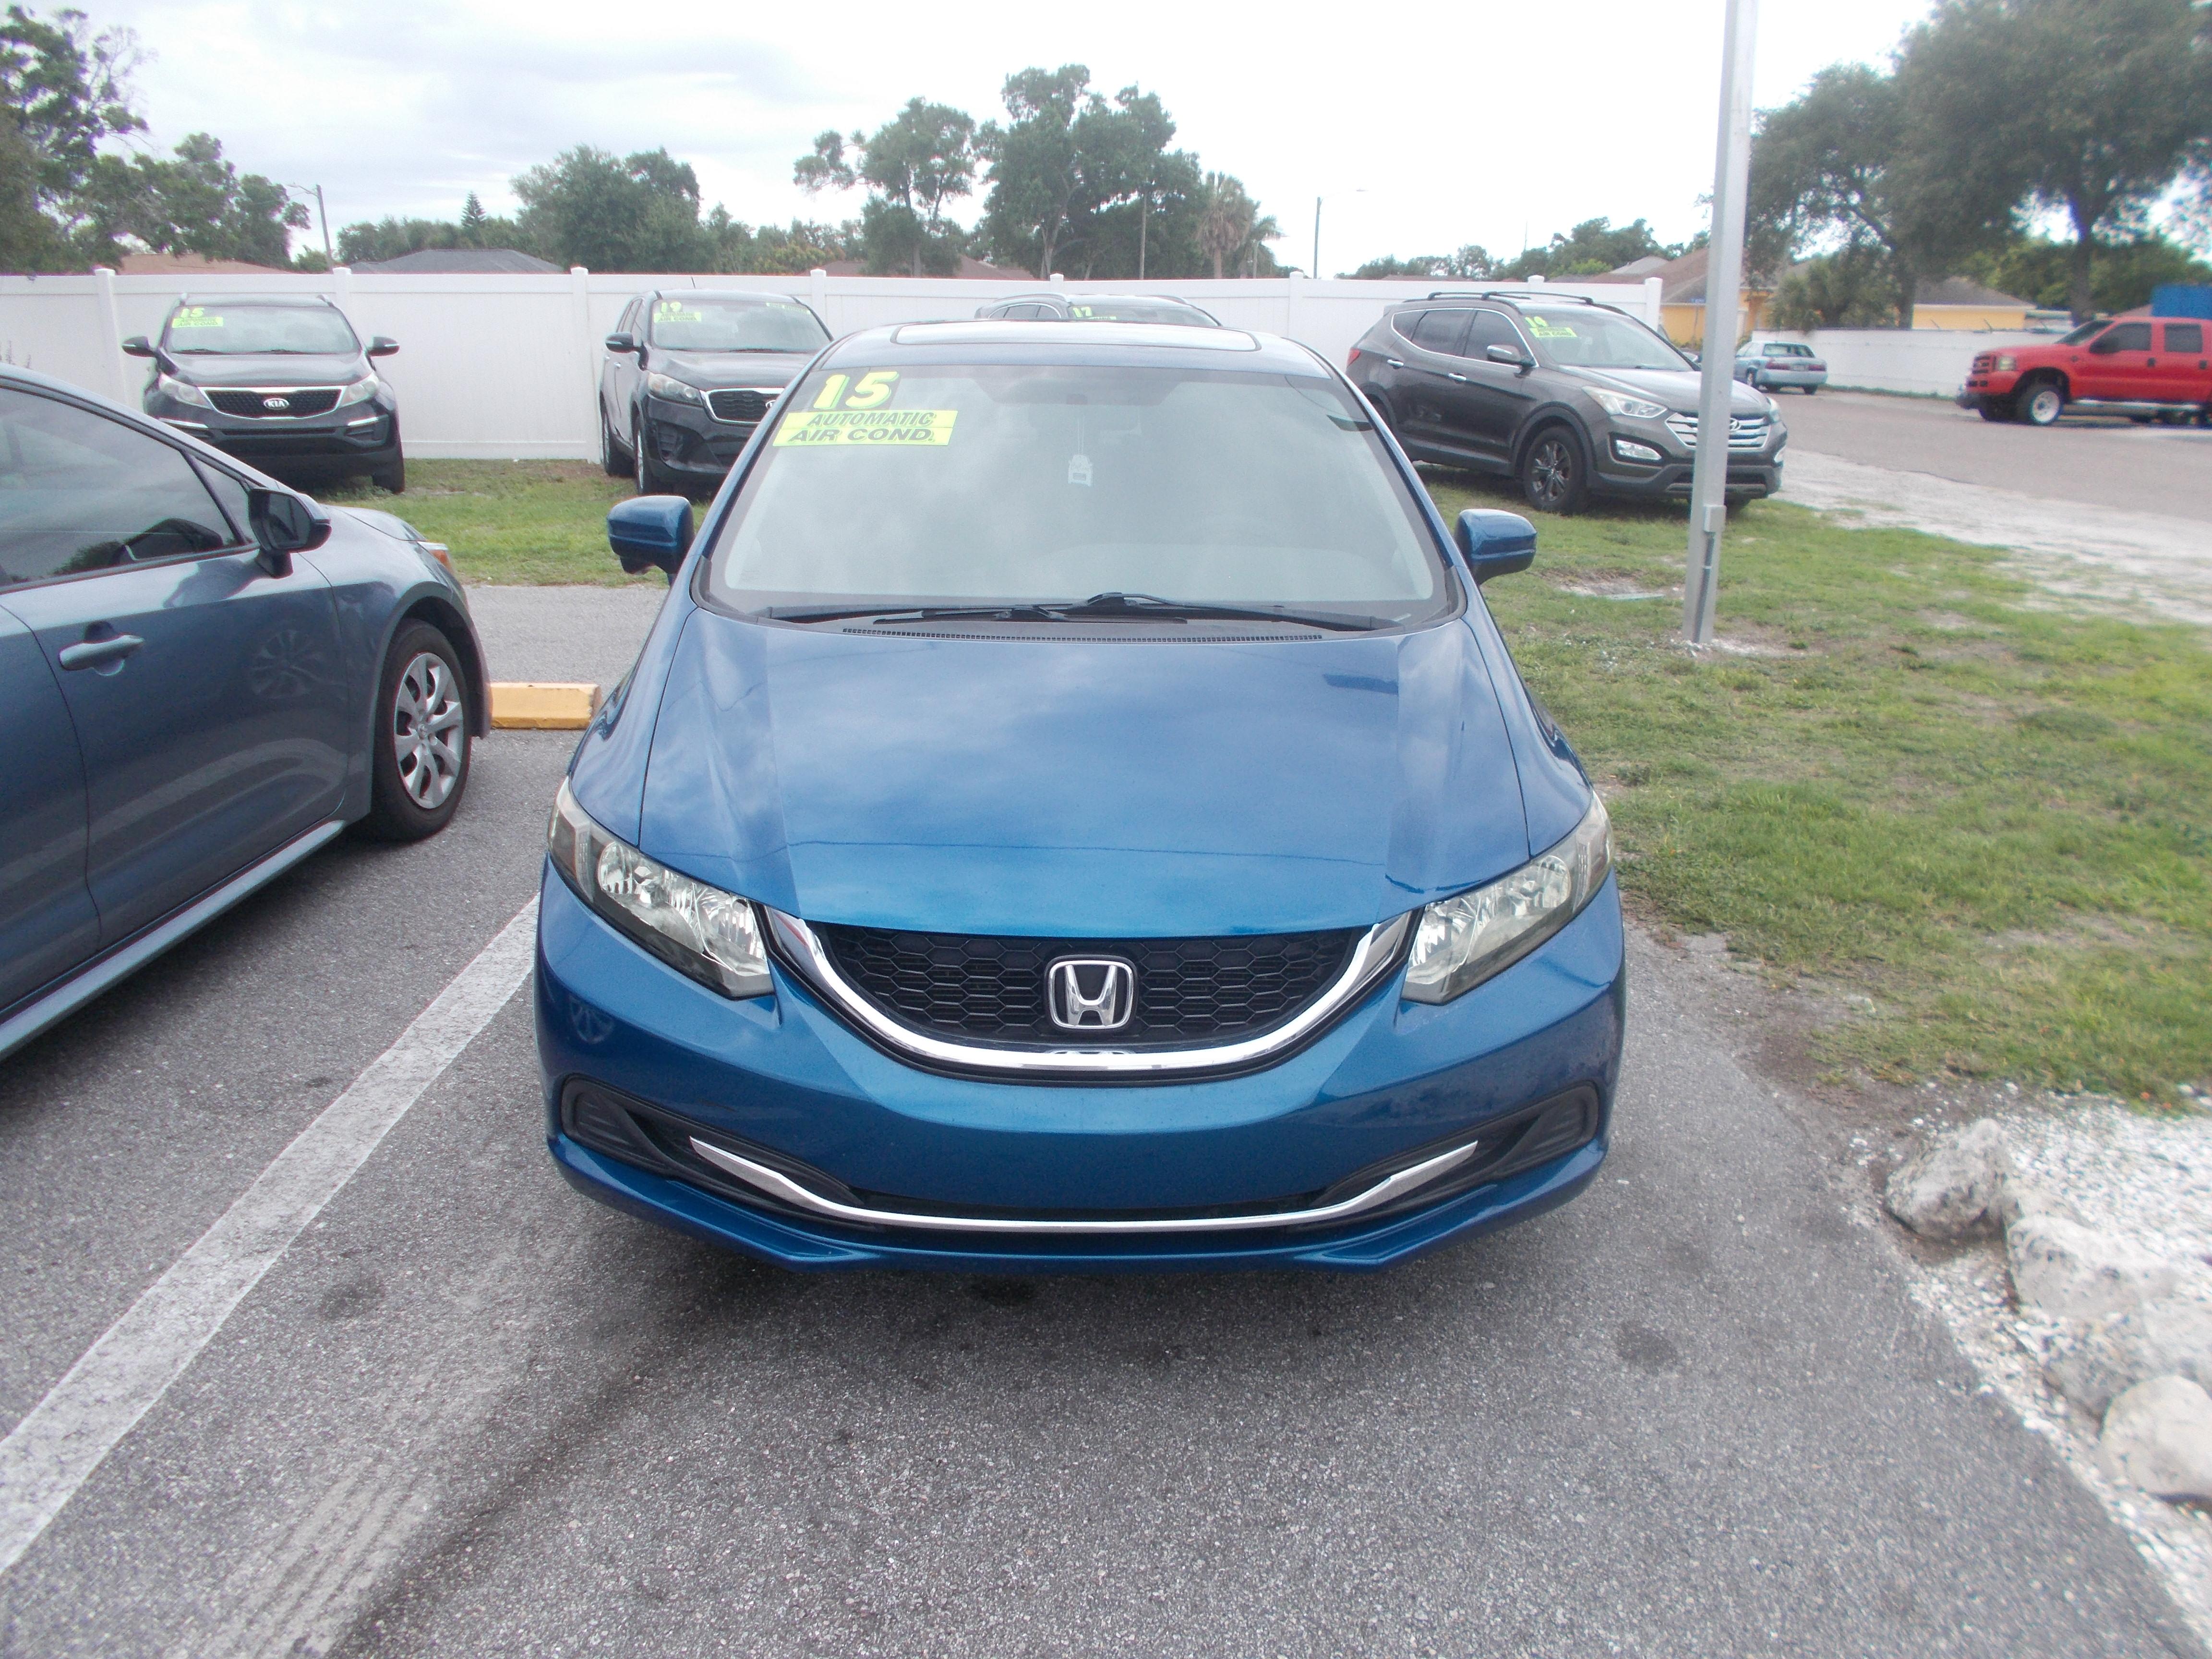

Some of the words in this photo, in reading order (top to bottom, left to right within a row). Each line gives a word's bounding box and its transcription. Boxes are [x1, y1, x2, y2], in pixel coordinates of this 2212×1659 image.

[181, 308, 204, 318] 15
[661, 302, 682, 313] 19
[1073, 307, 1092, 317] 17
[813, 371, 899, 409] 15
[267, 399, 286, 408] KIA
[806, 412, 937, 427] AUTOMATIC
[788, 429, 842, 442] AIR
[847, 428, 935, 442] COND.
